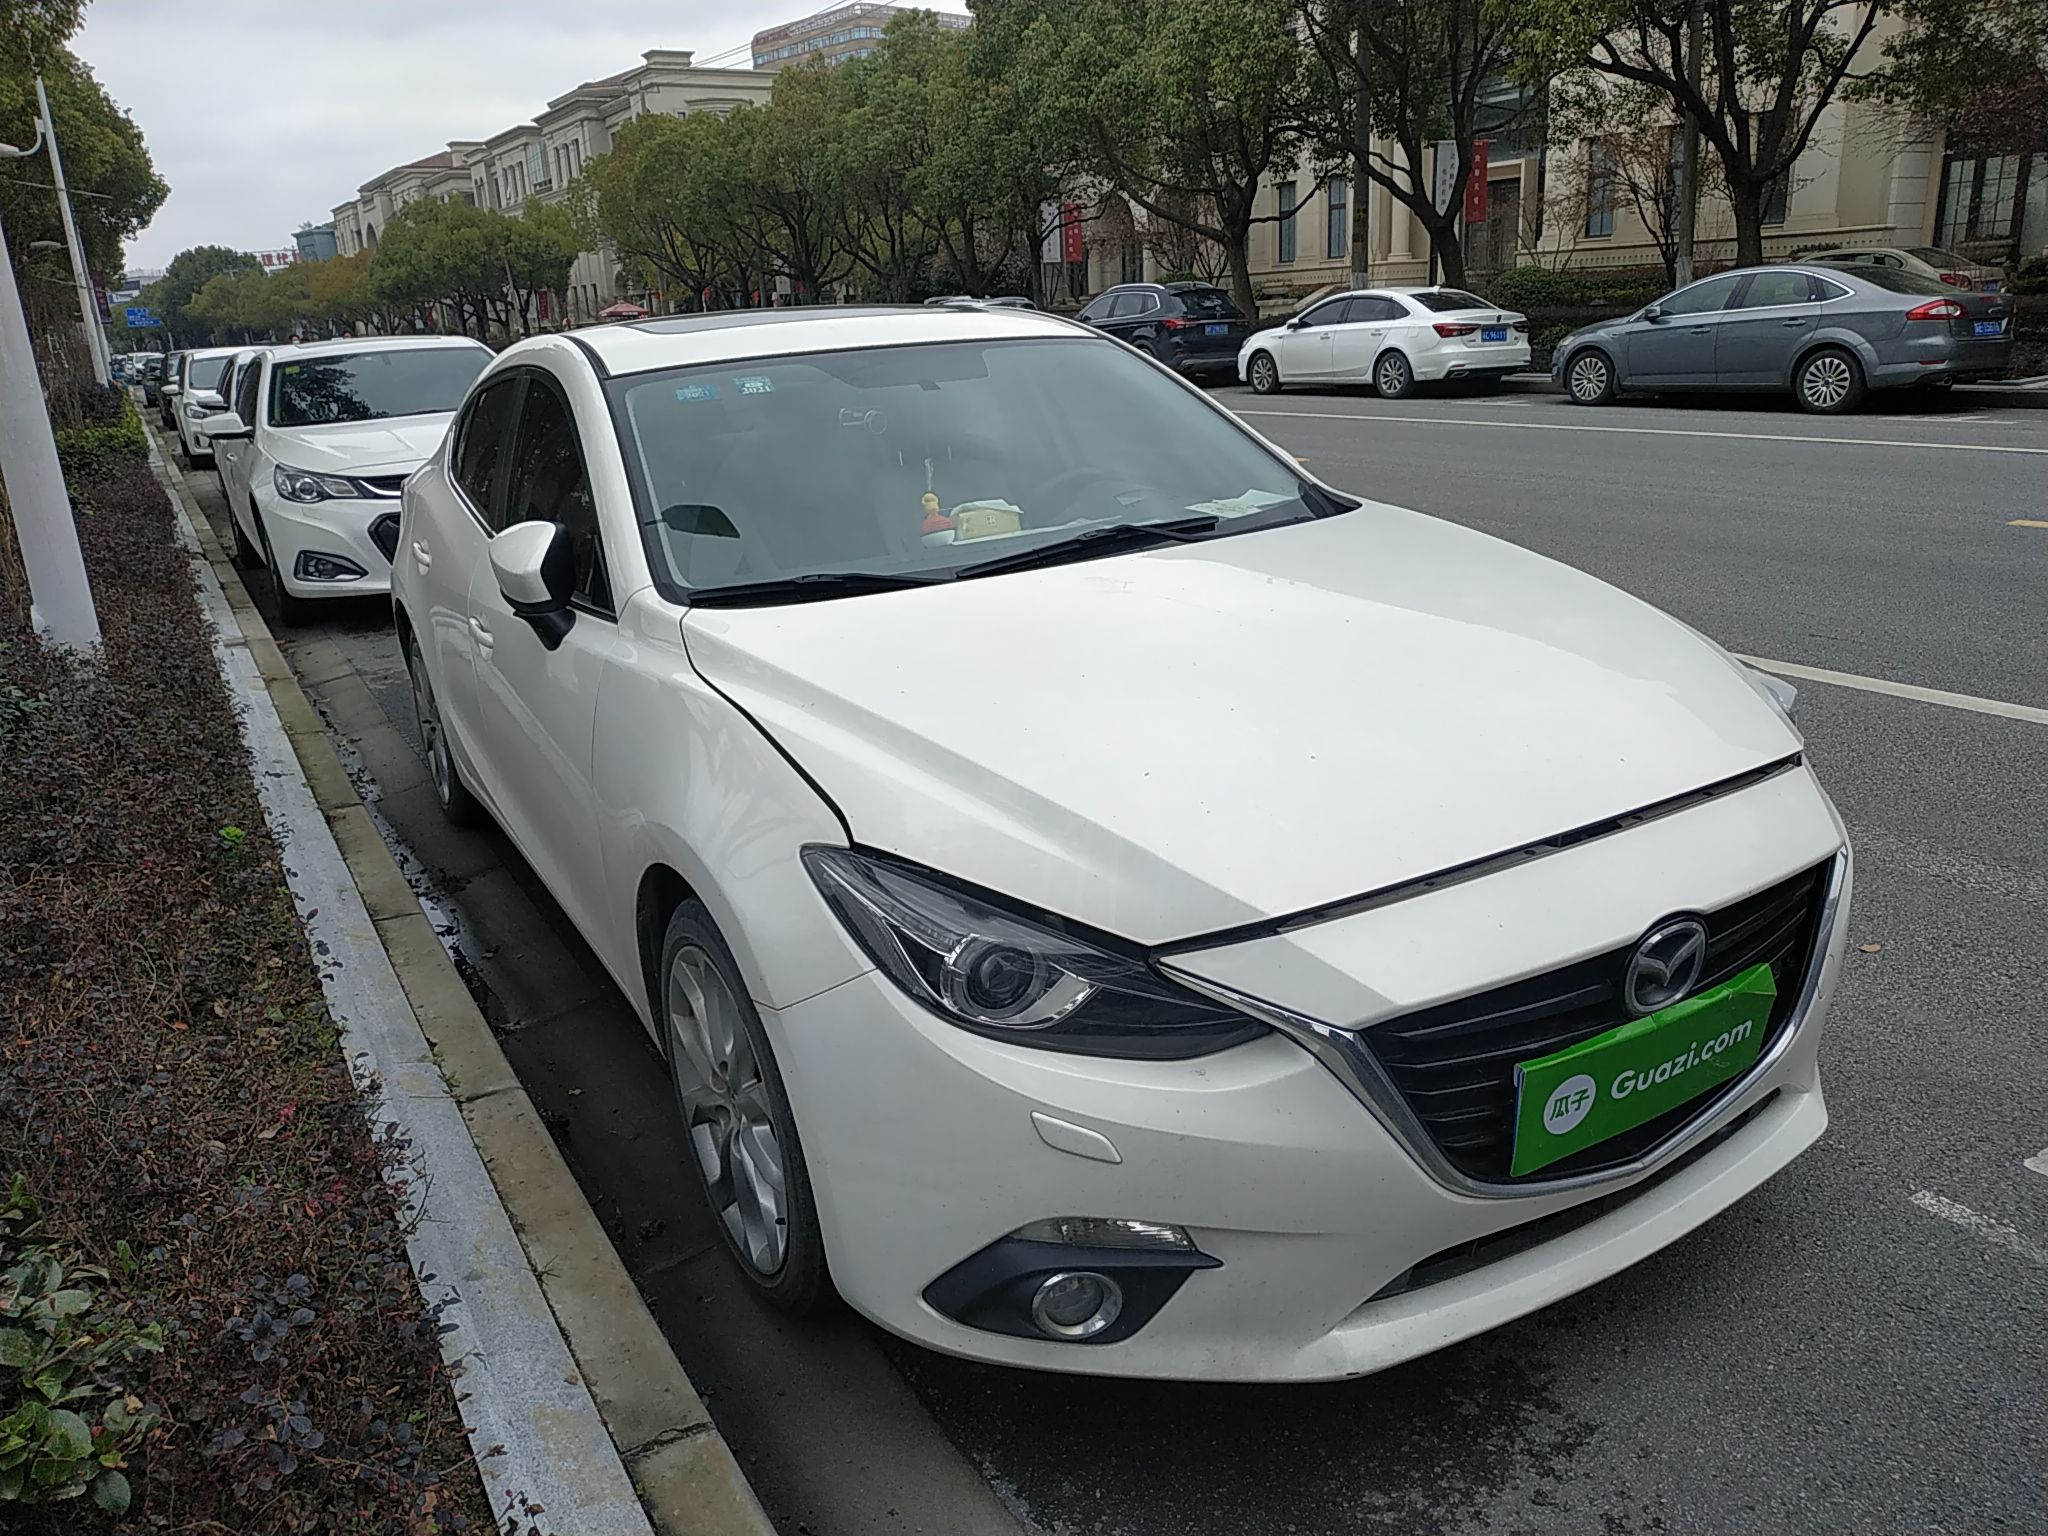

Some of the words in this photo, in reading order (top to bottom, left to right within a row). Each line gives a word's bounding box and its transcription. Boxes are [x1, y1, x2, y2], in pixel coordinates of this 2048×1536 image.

[742, 386, 771, 395] 2021
[1610, 1019, 1753, 1100] Guazi.com
[1548, 1087, 1591, 1122] 瓜子
